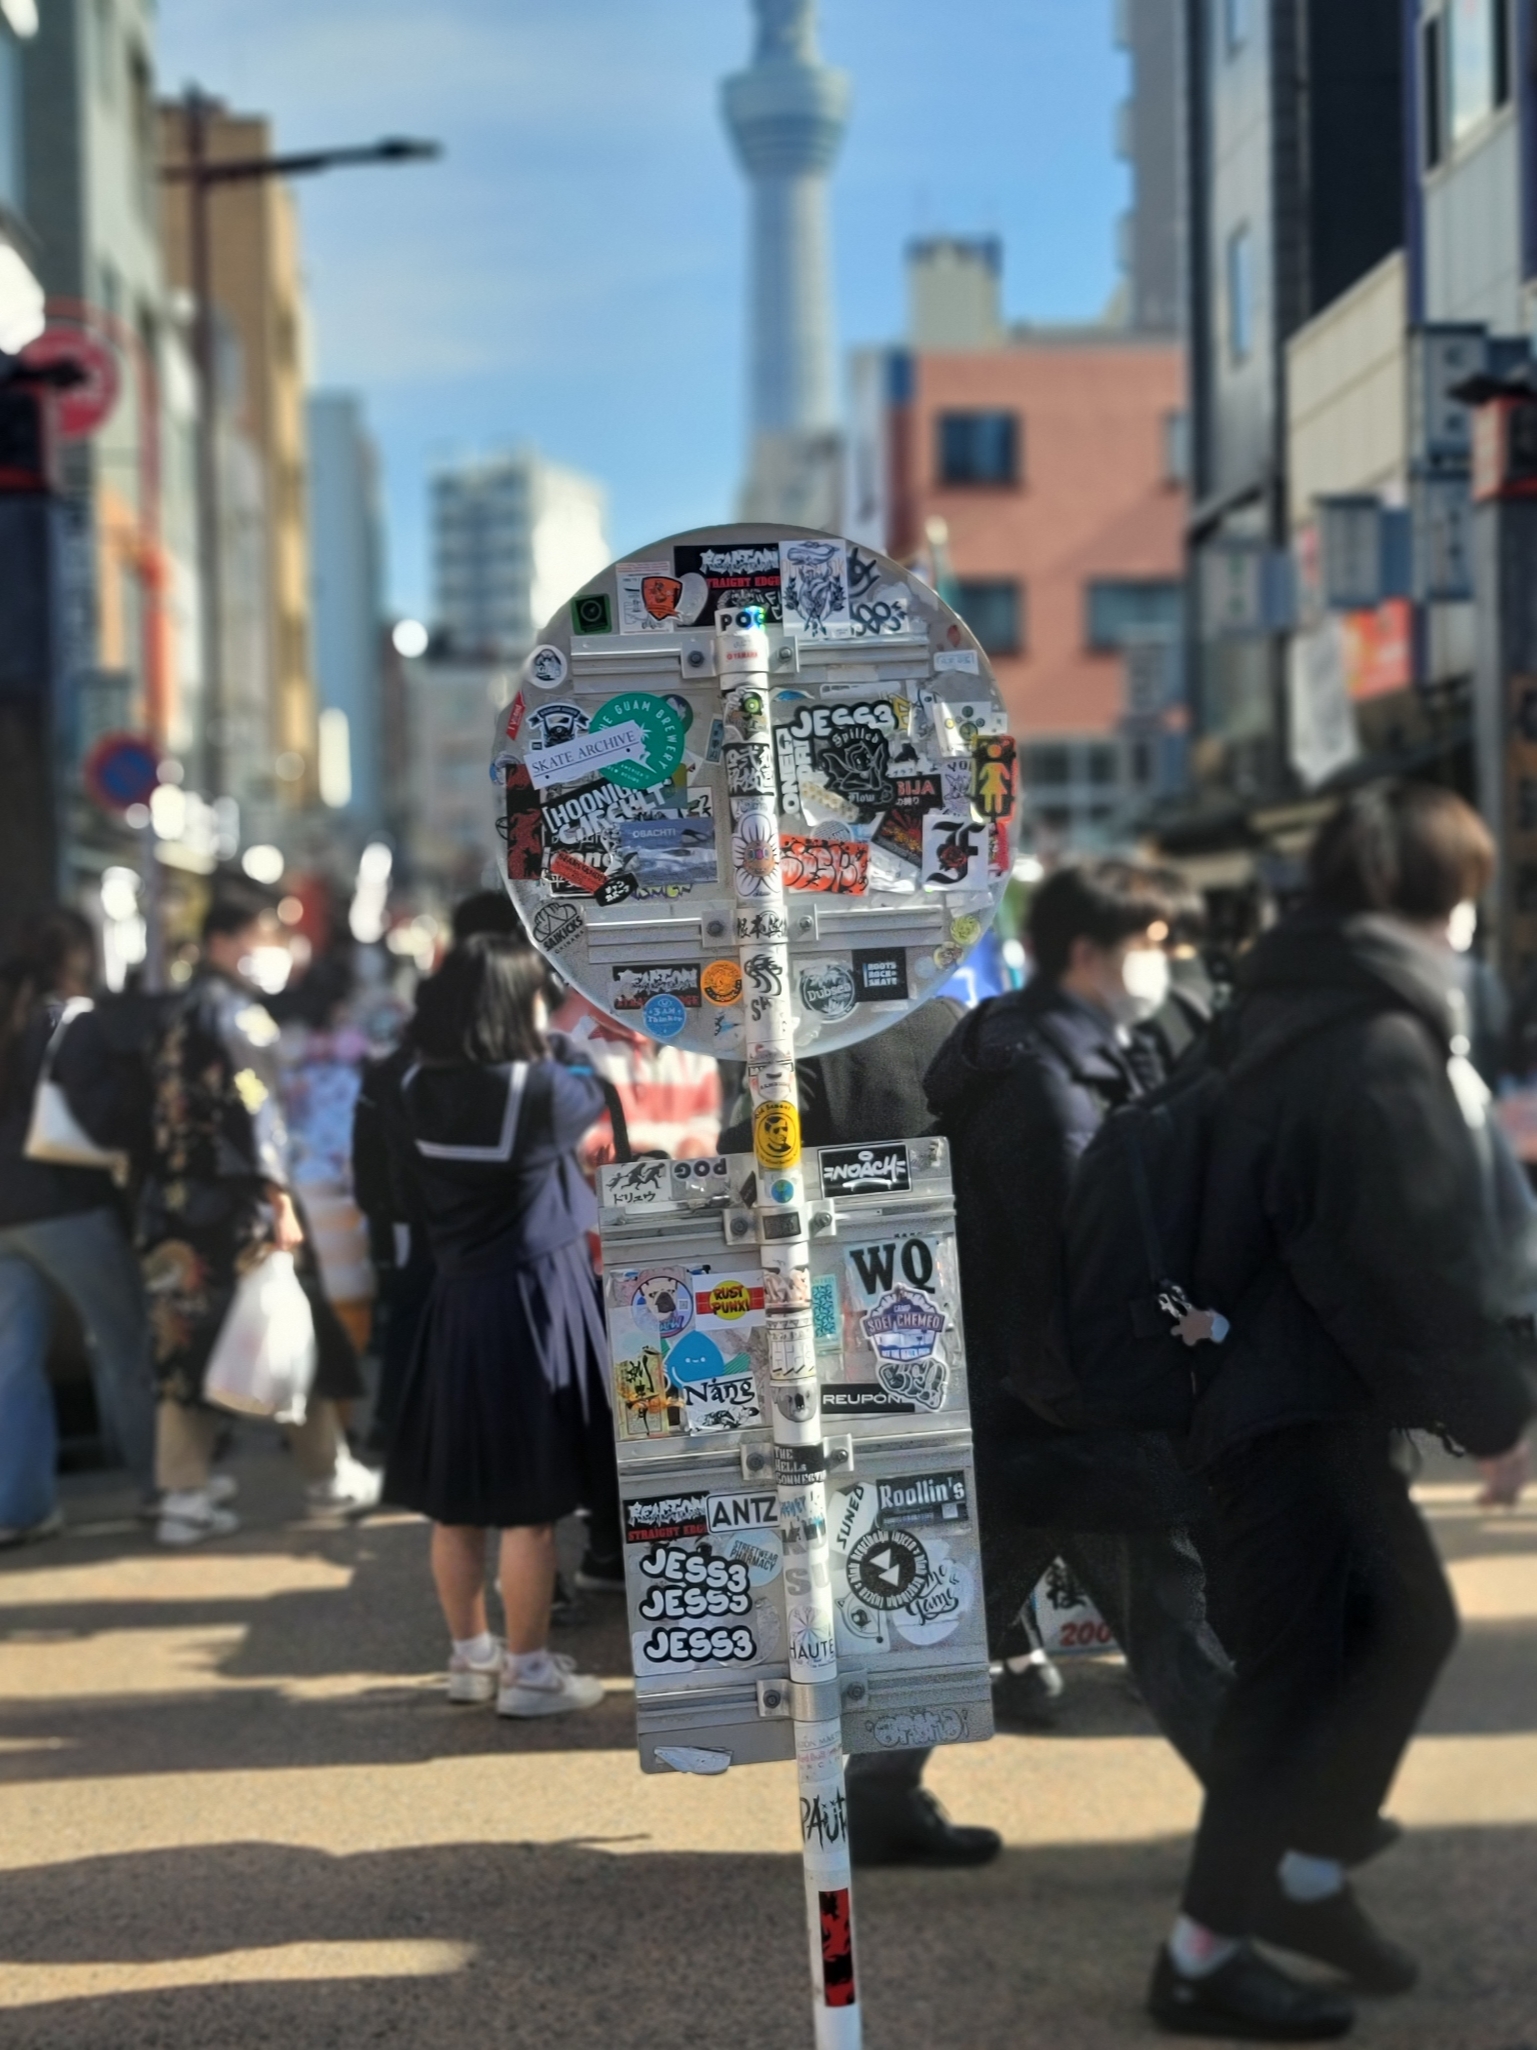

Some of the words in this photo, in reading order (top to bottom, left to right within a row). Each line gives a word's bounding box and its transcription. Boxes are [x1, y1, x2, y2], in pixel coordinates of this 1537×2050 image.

[614, 700, 651, 716] GUAM
[656, 707, 678, 771] BREWERY
[532, 749, 575, 774] SKATE
[578, 731, 637, 760] ARCHIVE
[543, 916, 584, 951] SAIKICKS
[868, 961, 897, 970] ROOTS
[674, 1157, 728, 1179] POG
[849, 1238, 936, 1295] WQ
[714, 1286, 744, 1301] RUST
[775, 1446, 793, 1459] THE
[879, 1476, 965, 1509] Roollin's
[712, 1496, 778, 1528] ANTZ
[729, 1550, 777, 1573] PHARMACY
[734, 1540, 779, 1563] STREETWEAR
[642, 1548, 747, 1593] JESS3
[646, 1629, 753, 1659] JESS3
[790, 1638, 834, 1659] HAUTE
